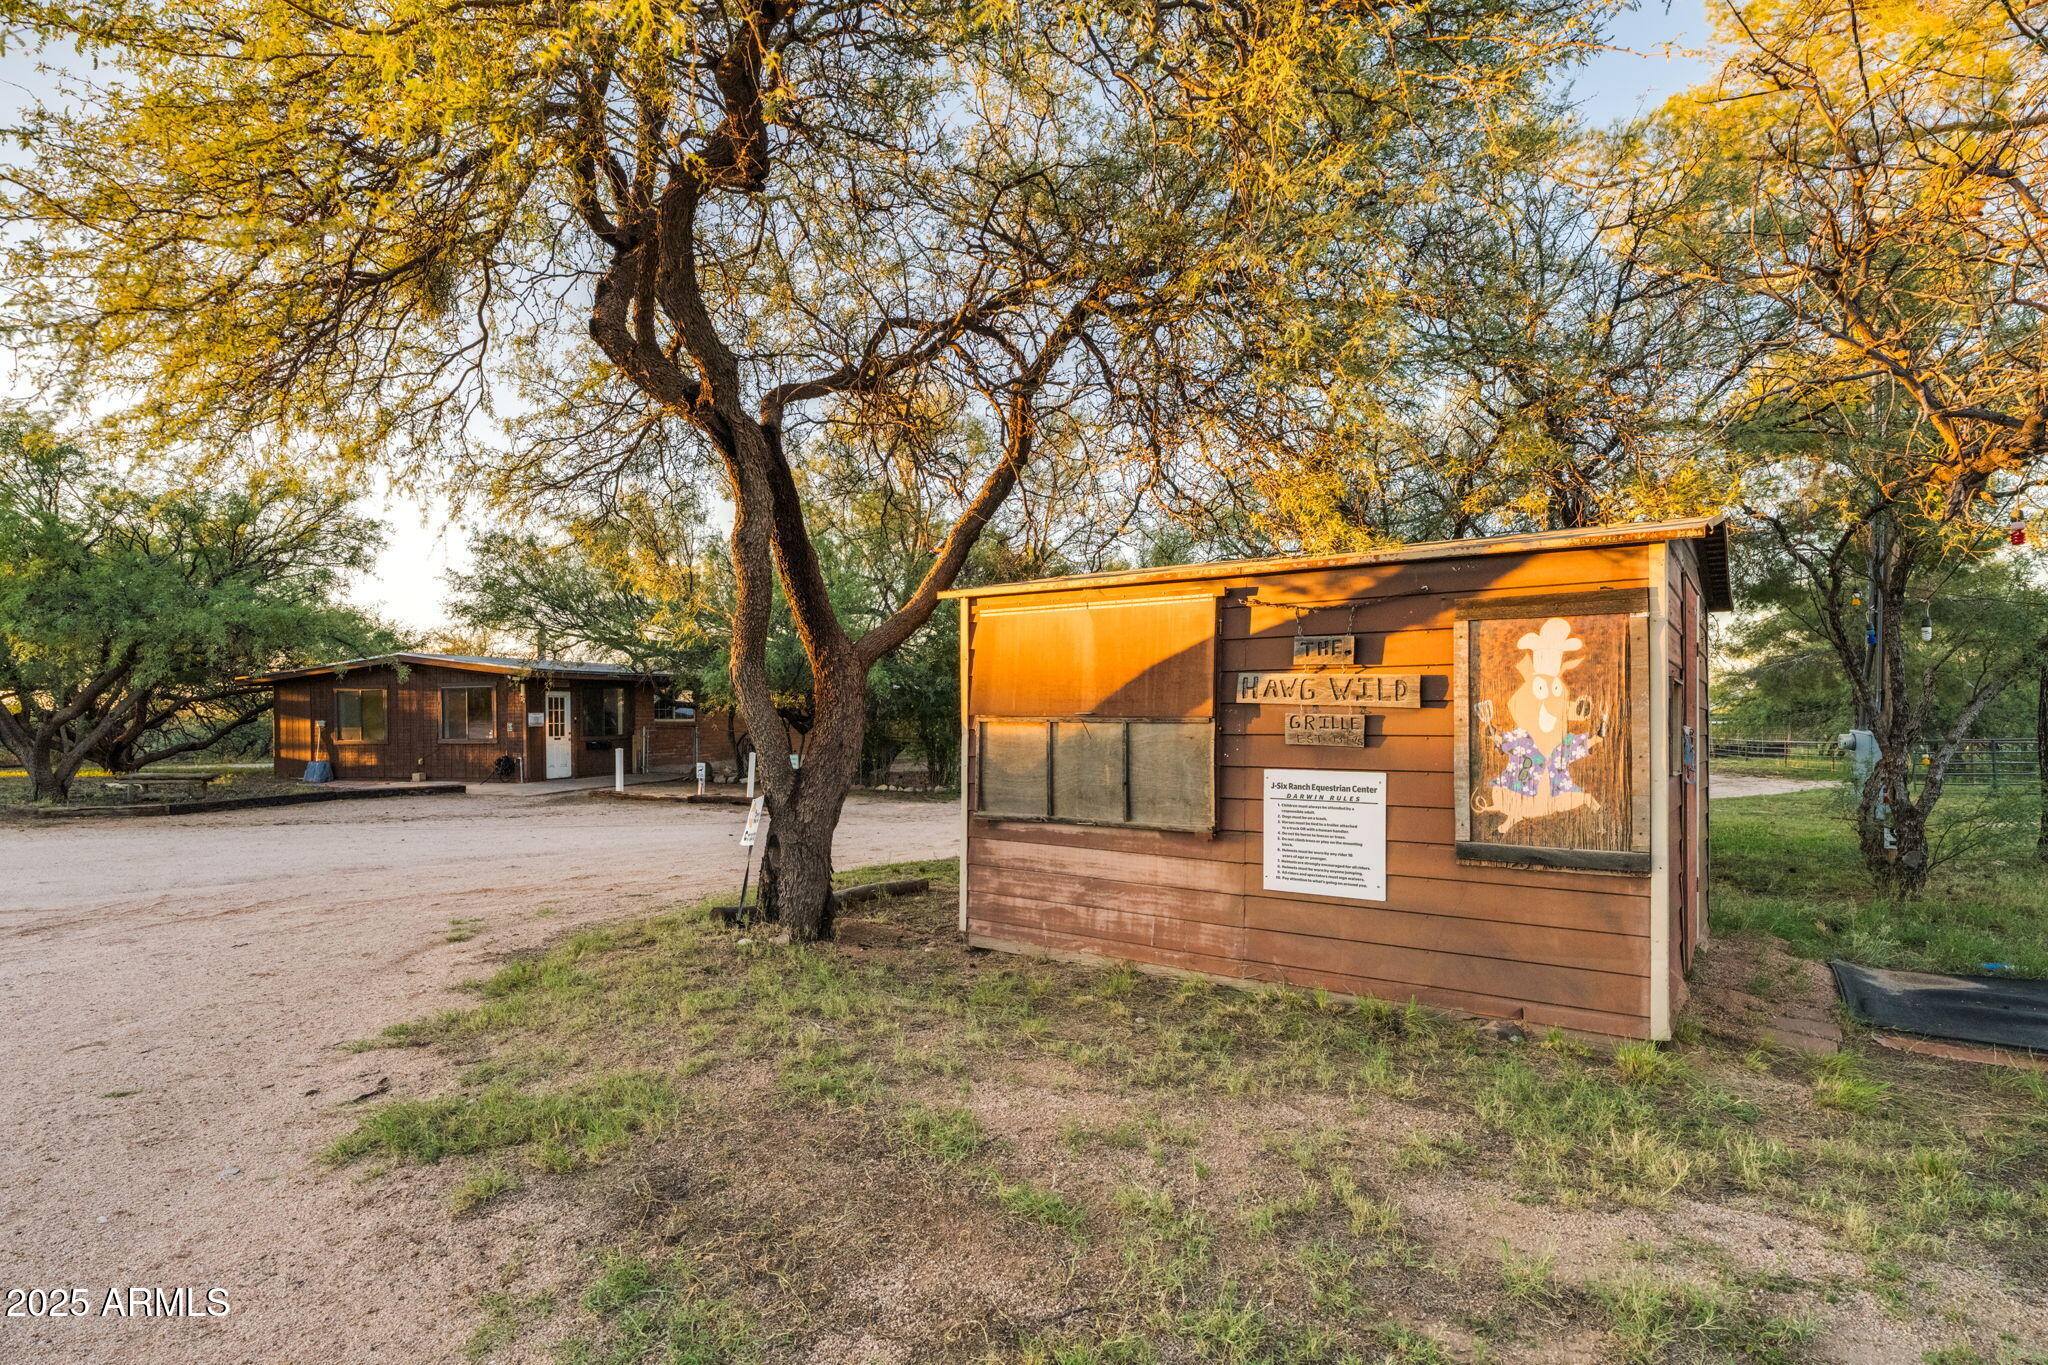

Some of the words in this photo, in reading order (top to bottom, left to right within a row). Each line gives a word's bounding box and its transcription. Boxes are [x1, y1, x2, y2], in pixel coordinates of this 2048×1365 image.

[1300, 639, 1342, 656] THE
[1242, 676, 1315, 700] HAWG
[1329, 678, 1407, 701] WILD
[1290, 715, 1359, 730] GRILLE
[1311, 784, 1350, 792] Equestrian
[1352, 785, 1378, 793] Center
